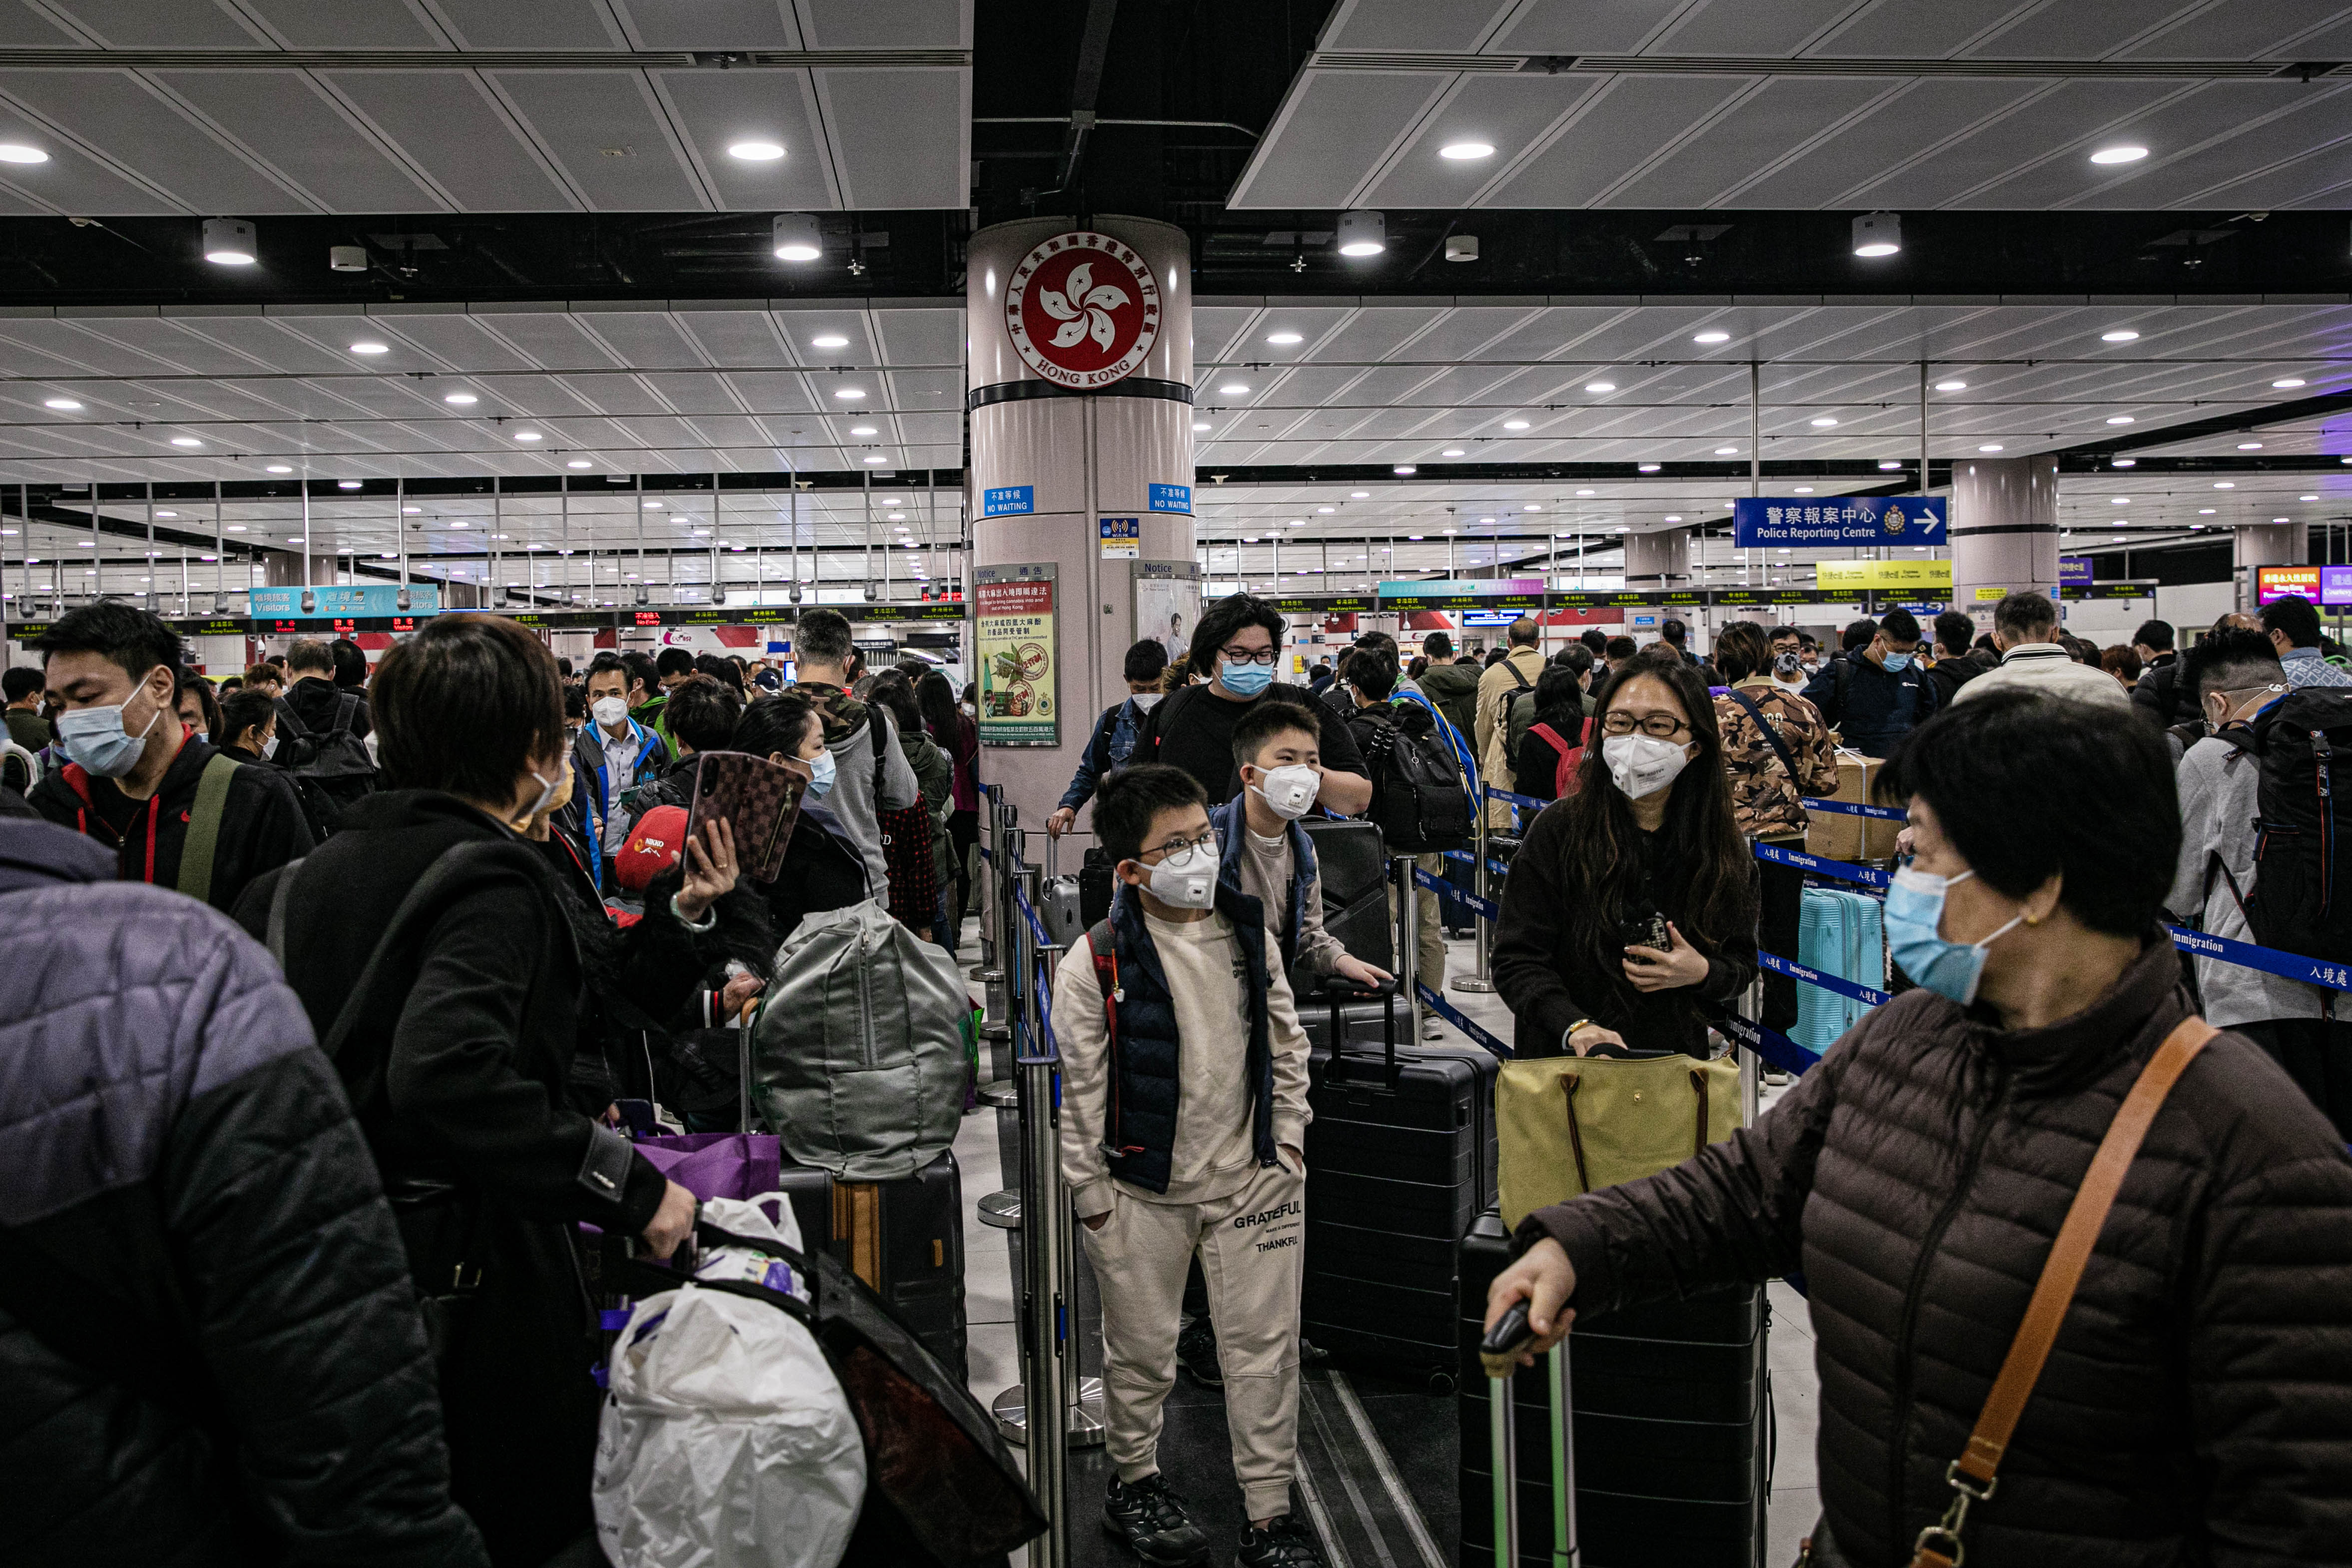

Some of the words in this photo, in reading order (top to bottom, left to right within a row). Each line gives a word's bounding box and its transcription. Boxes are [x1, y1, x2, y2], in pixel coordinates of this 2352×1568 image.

[1036, 359, 1080, 384] HONG
[1088, 360, 1131, 385] KONG
[991, 490, 1021, 501] 不准等候
[1161, 487, 1185, 499] 不准等候
[987, 505, 996, 513] NO
[997, 502, 1027, 512] WAITING
[1167, 501, 1189, 510] WAITING
[1766, 507, 1877, 525] 警察報案中心
[1757, 527, 1788, 538] Police
[1790, 527, 1840, 541] Reporting
[1842, 527, 1876, 538] Centre
[977, 569, 995, 579] Notice
[1019, 566, 1043, 576] 通告
[1144, 563, 1172, 572] Notice
[255, 603, 290, 612] Visitors
[409, 601, 434, 609] sitors
[1865, 806, 1887, 816] Immigration
[645, 837, 665, 848] NIKKO
[1764, 848, 1780, 860] 入境處
[1789, 852, 1817, 868] Immigration
[1858, 870, 1877, 884] 入境處
[1465, 893, 1484, 911] Immigration
[2169, 929, 2224, 953] Immigration
[1765, 957, 1781, 970] 入境處
[1789, 963, 1818, 981] Immigration
[2309, 966, 2348, 987] 入境處
[1859, 990, 1878, 1004] 入境處
[1468, 1022, 1487, 1044] Immigration
[1726, 1013, 1761, 1045] Immigration
[1234, 1200, 1302, 1229] GRATEFUL
